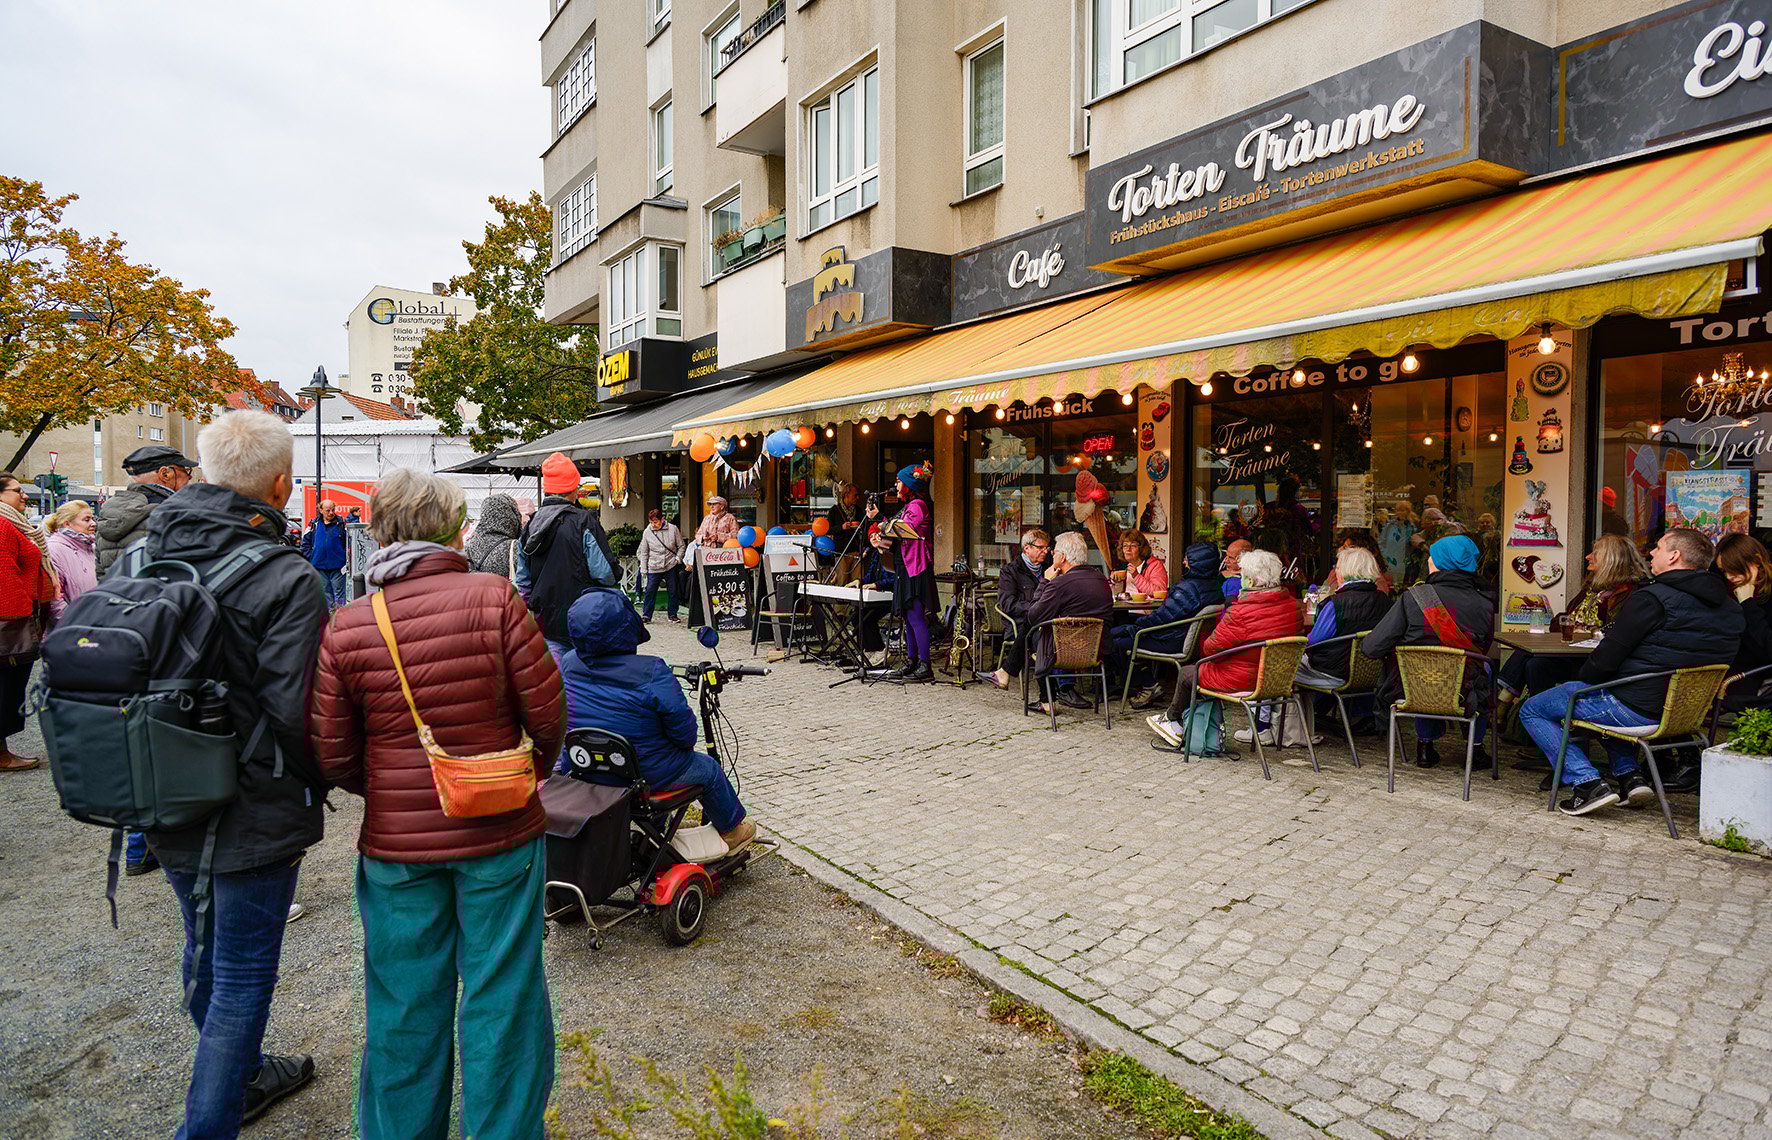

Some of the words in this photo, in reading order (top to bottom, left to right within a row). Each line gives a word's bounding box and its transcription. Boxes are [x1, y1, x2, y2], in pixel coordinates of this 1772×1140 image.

[1107, 164, 1227, 223] Torten
[1234, 94, 1426, 182] Träume
[1109, 205, 1208, 244] Frühstückshaus
[1218, 184, 1270, 213] Eiscafé
[1280, 138, 1425, 194] Tortenwerkstatt
[1008, 243, 1065, 289] Café
[367, 298, 444, 325] Global
[398, 317, 445, 325] Bestattungen
[597, 349, 630, 387] ÖZEM
[1336, 363, 1368, 383] to
[949, 388, 1010, 405] Träume
[1083, 435, 1114, 452] OPEN
[1215, 417, 1277, 455] Torten
[1216, 449, 1291, 486] Träume
[710, 567, 740, 577] Frühstück
[775, 572, 796, 582] Coffee
[709, 586, 717, 595] ab
[717, 581, 737, 595] 3,90
[739, 580, 746, 592] €
[574, 749, 587, 765] 6
